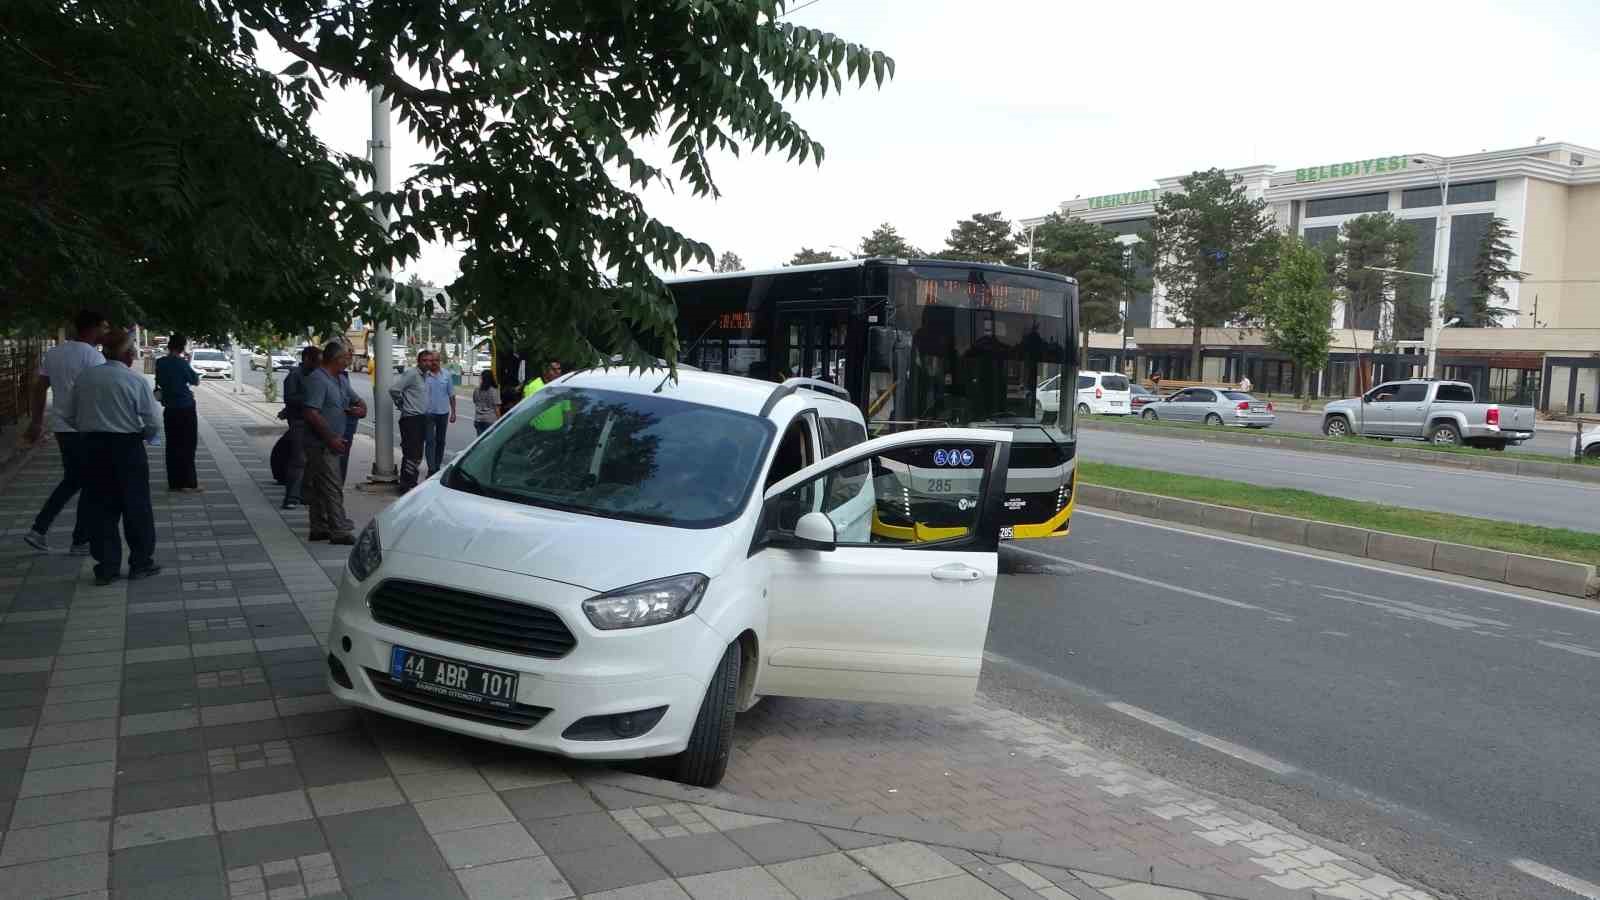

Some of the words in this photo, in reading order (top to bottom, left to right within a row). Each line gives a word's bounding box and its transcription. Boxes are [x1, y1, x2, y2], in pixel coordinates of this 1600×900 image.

[928, 479, 951, 492] 285
[405, 656, 425, 679] 44
[435, 662, 469, 689] ABR
[481, 671, 512, 699] 101
